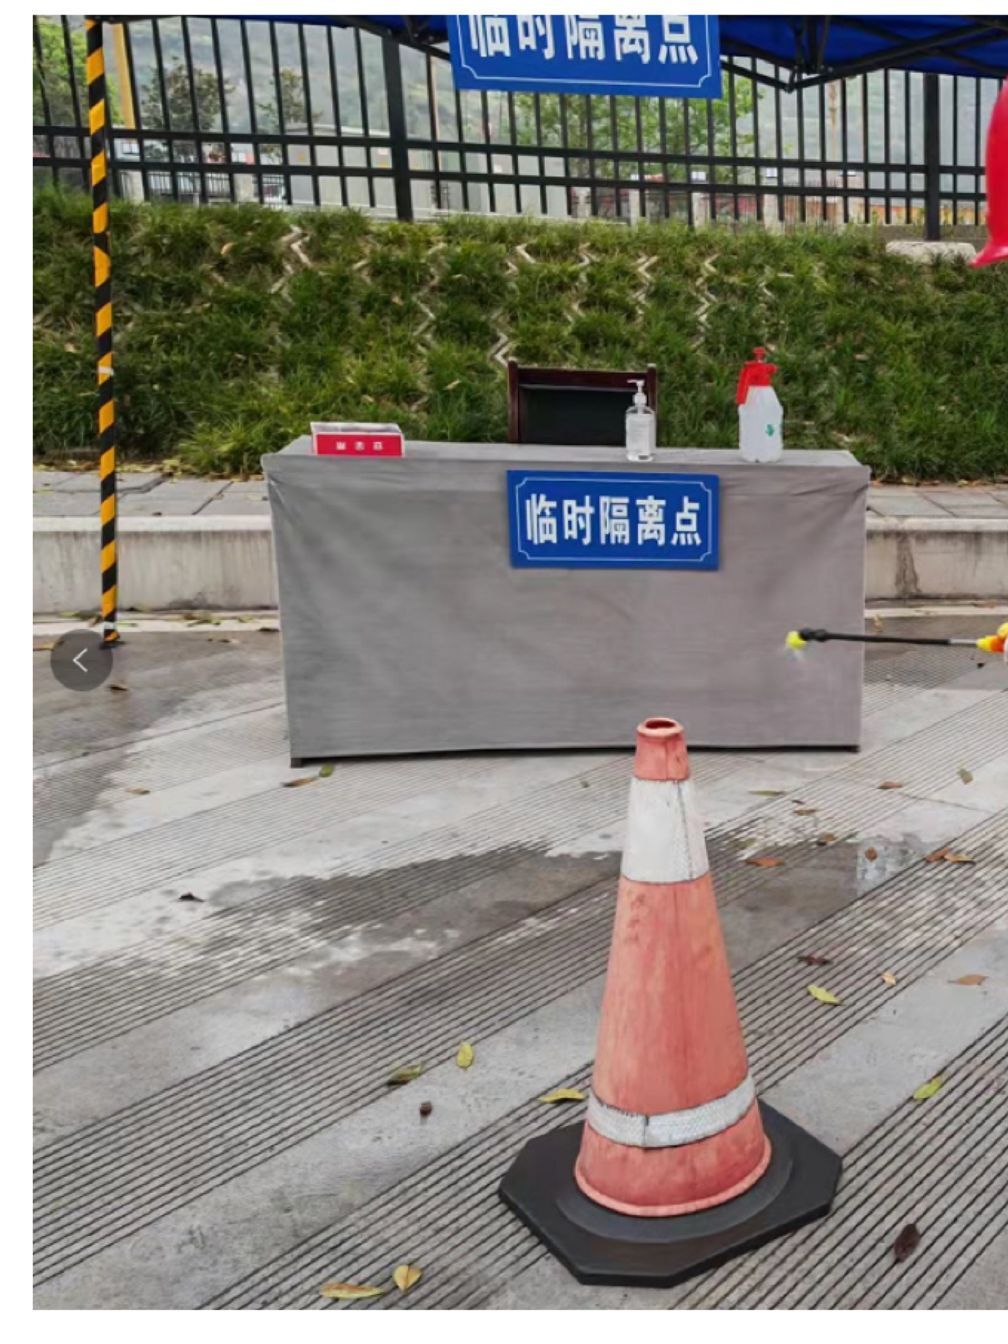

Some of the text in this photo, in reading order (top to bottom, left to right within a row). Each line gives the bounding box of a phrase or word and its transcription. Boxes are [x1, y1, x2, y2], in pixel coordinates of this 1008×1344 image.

[525, 493, 702, 547] 临时隔离点
